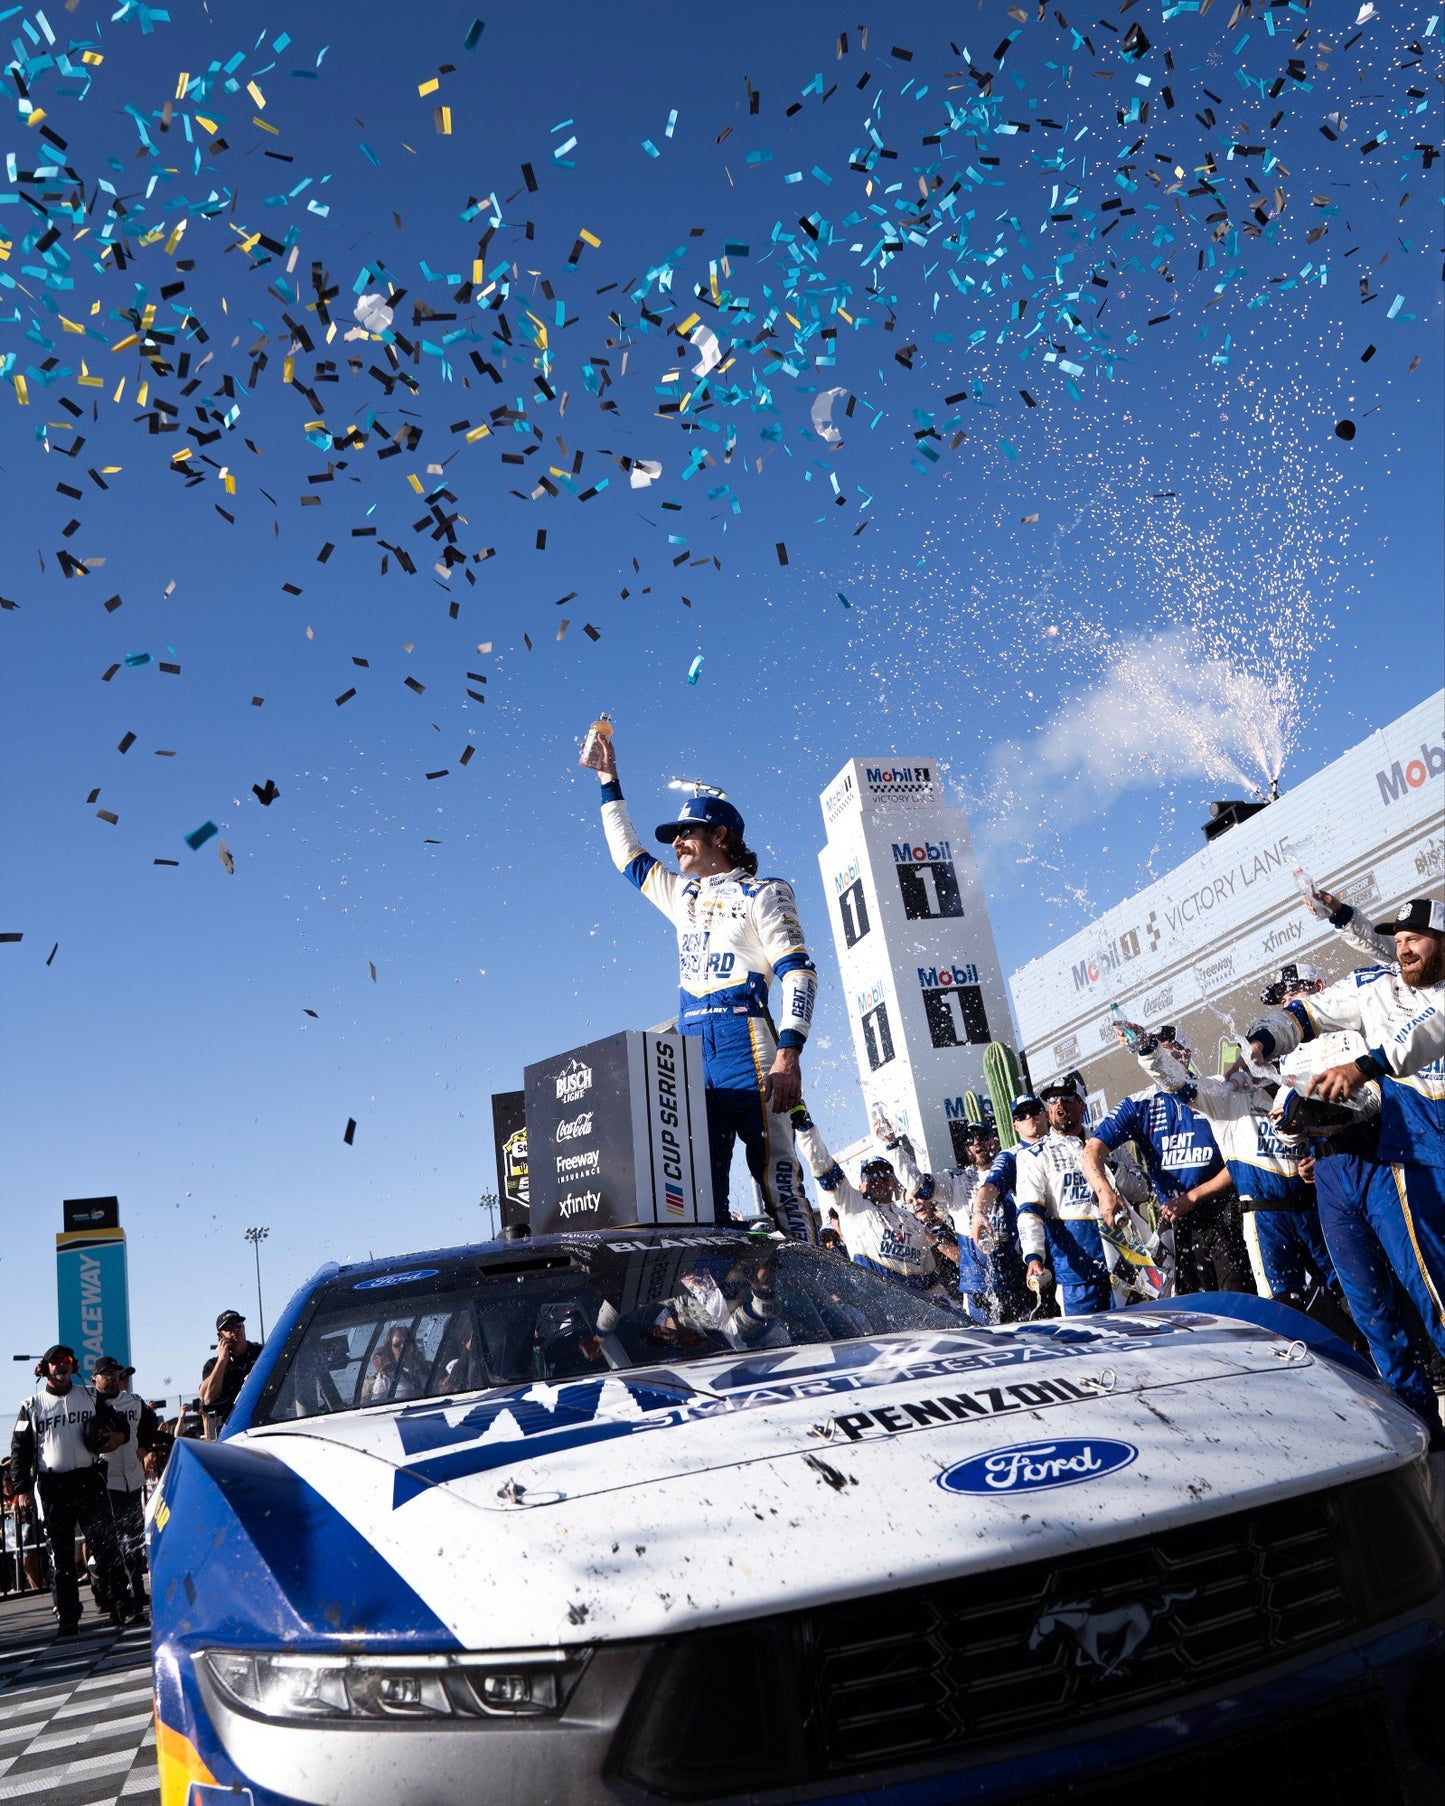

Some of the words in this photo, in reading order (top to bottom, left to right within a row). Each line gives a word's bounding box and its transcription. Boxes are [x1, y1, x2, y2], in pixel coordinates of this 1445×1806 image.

[866, 768, 913, 782] Mobil
[1376, 733, 1445, 806] Mob
[872, 794, 909, 805] VICTORY
[891, 841, 953, 862] Mobil
[834, 858, 861, 893] Mobil
[1164, 870, 1236, 931] VICTORY
[1261, 920, 1303, 954] xfinity
[917, 964, 979, 987] Mobil
[791, 987, 806, 1019] DENT
[857, 980, 884, 1014] Mobil
[1394, 1006, 1437, 1044] WIZARD
[556, 1068, 592, 1098] BUSCH
[562, 1090, 585, 1104] LIGHT
[656, 1041, 679, 1128] SERIES
[662, 1134, 683, 1181] CUP
[1161, 1132, 1195, 1151] DENT
[557, 1150, 600, 1173] Freeway
[558, 1167, 600, 1184] INSURANCE
[1064, 1171, 1088, 1187] DEN
[559, 1189, 601, 1219] xfinity
[786, 1207, 807, 1242] ENT
[606, 1236, 752, 1253] BLANEY
[79, 1253, 104, 1372] RACEWAY
[632, 1373, 868, 1432] SMART
[833, 1377, 1097, 1442] PENNZOIL
[984, 1445, 1103, 1490] Ford
